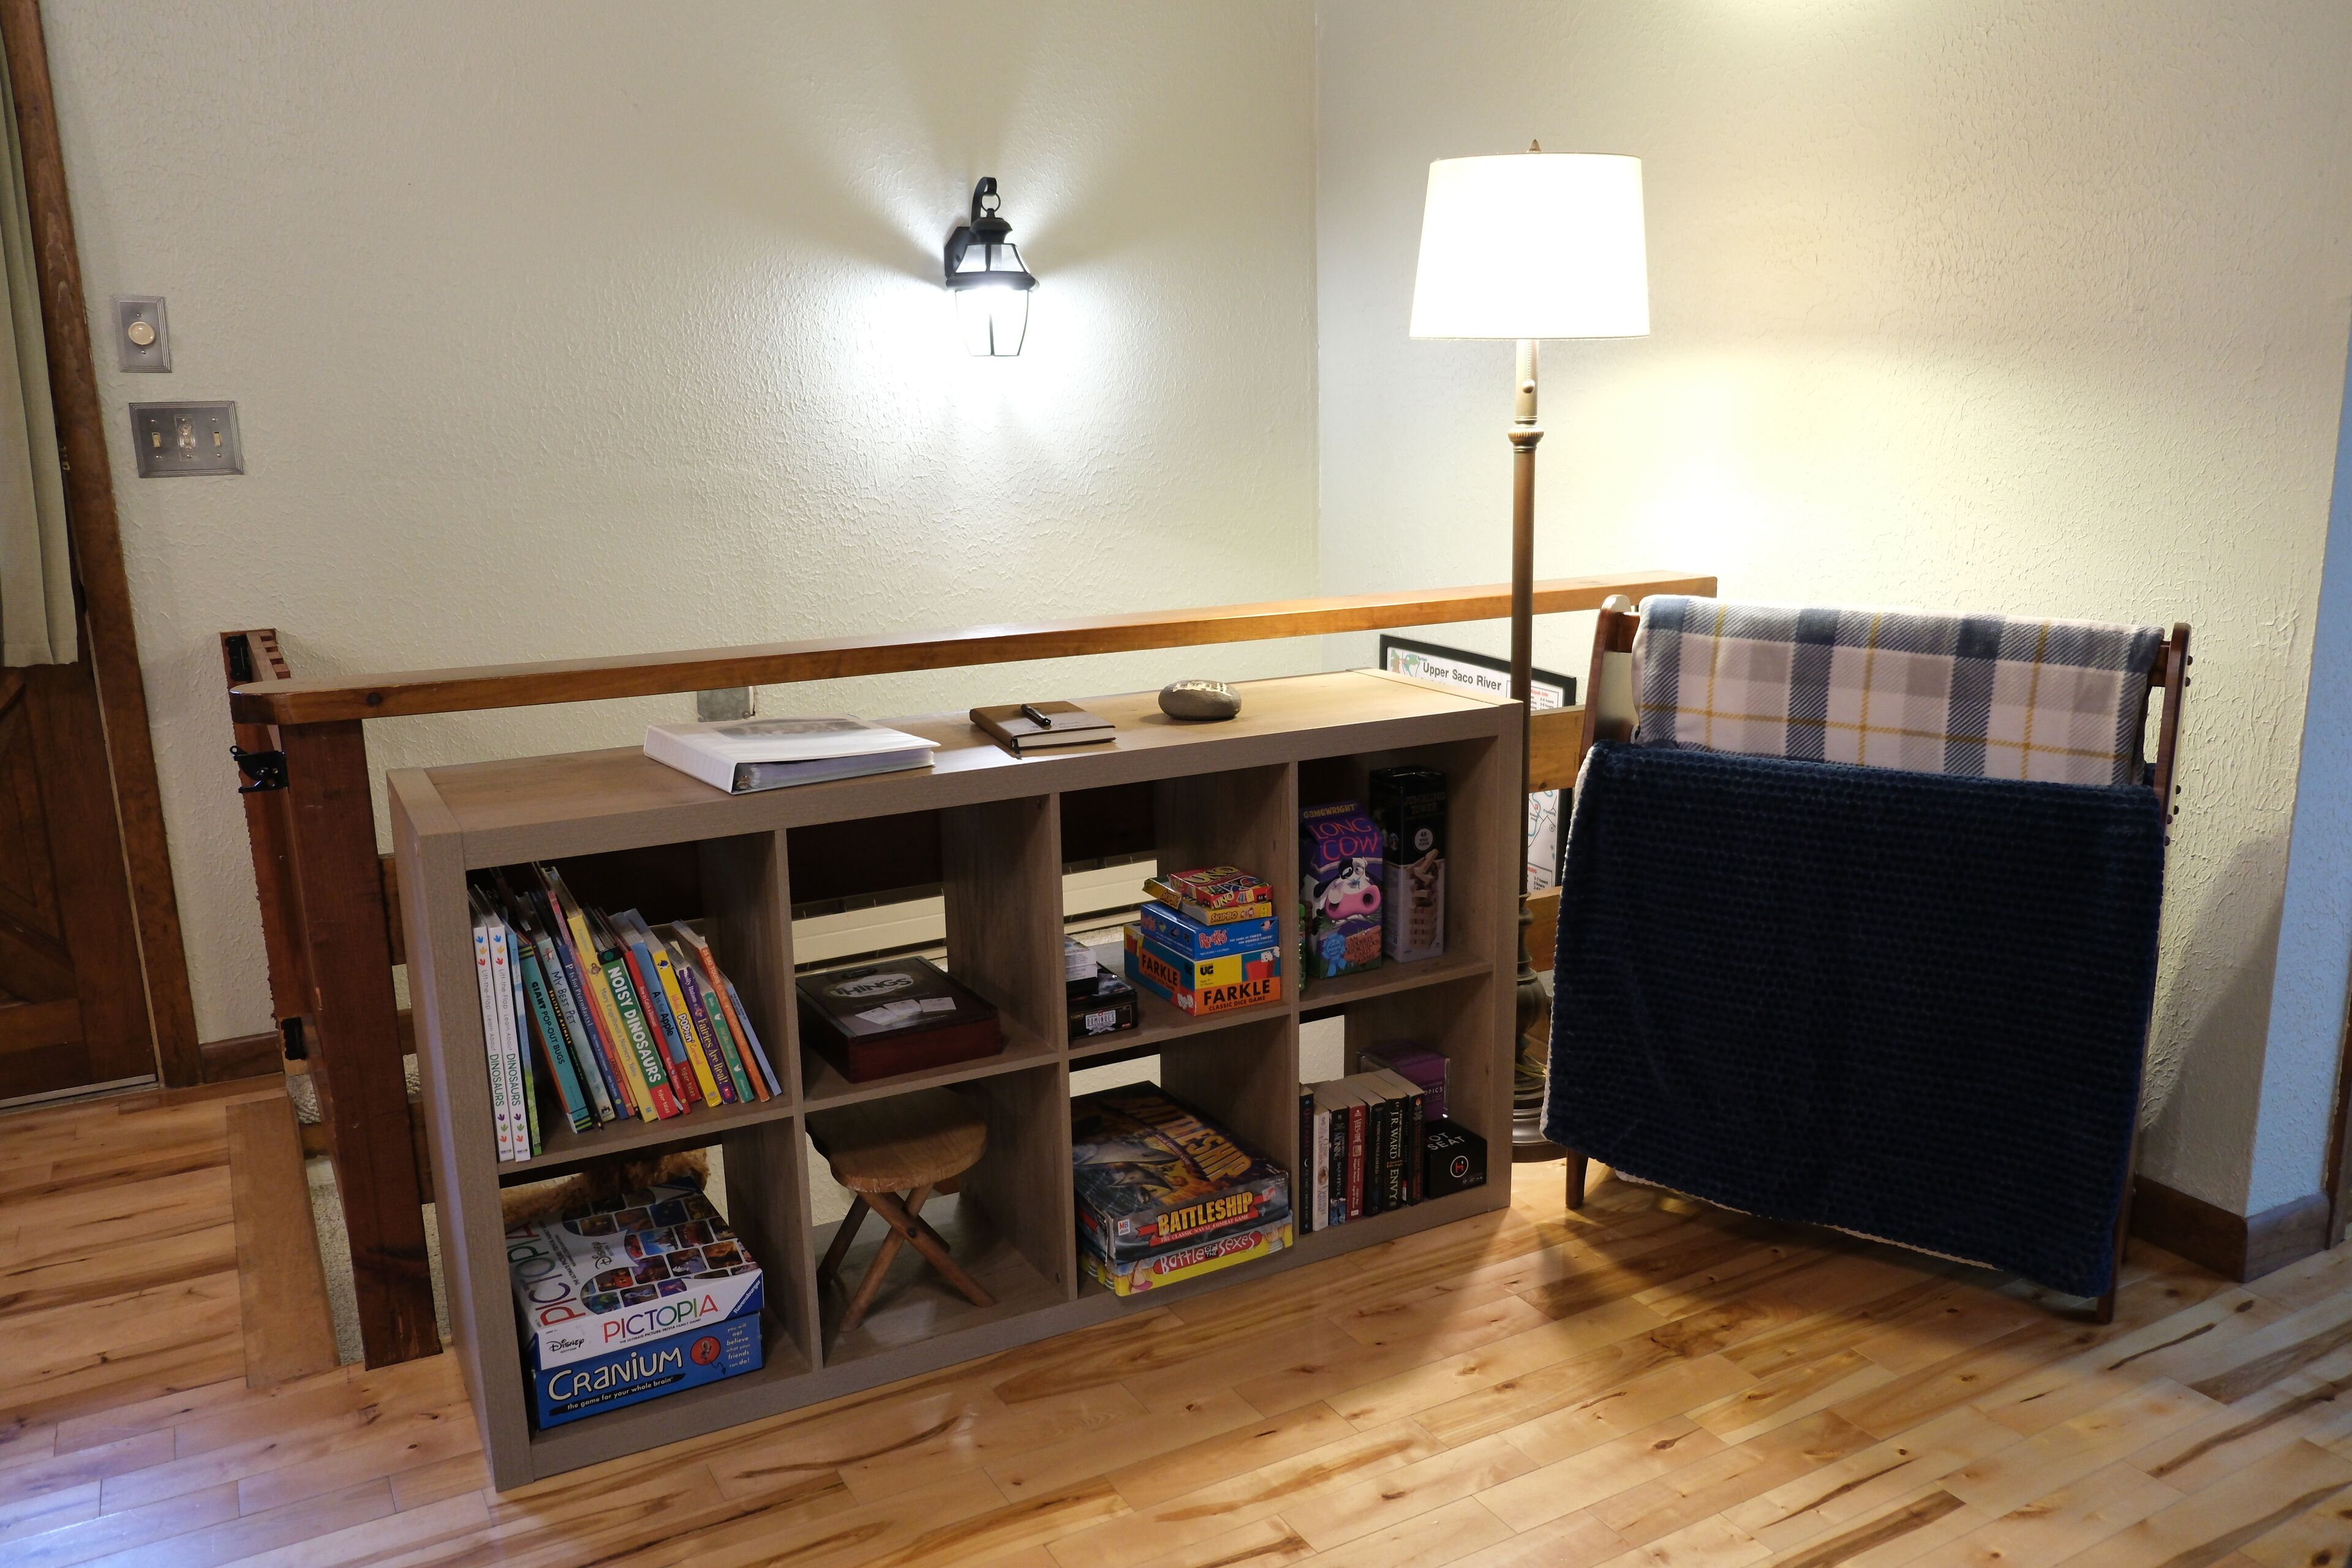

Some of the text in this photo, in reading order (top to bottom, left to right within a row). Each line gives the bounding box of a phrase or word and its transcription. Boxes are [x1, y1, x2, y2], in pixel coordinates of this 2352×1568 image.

[1423, 662, 1449, 678] Upper
[1452, 669, 1474, 684] Saco
[1476, 674, 1502, 691] River
[1308, 817, 1373, 839] LONG
[1323, 833, 1378, 861] COW
[1183, 865, 1240, 884] UNO
[1212, 891, 1235, 908] UNO
[564, 962, 574, 971] P
[570, 978, 579, 988] for
[709, 965, 720, 984] TOURS
[1142, 953, 1178, 987] FARKLE
[551, 970, 578, 1025] MY BEST PET
[834, 978, 912, 995] THINGS
[1204, 979, 1270, 1006] FARKLE
[1208, 1001, 1232, 1011] CLASSIC
[531, 981, 565, 1065] GIANT POP-OUT BUGS
[559, 1018, 572, 1044] ANIMALS
[598, 987, 611, 1004] Mary
[618, 1038, 633, 1061] Nursery
[607, 965, 662, 1084] NOISY DINOSAURS
[657, 1011, 676, 1038] Apple
[697, 1017, 715, 1048] Fairies
[1086, 1014, 1115, 1026] DOMINOES
[481, 969, 491, 1011] Lift-the-Flap
[489, 1054, 505, 1107] DINOSAURS
[499, 968, 508, 1009] Lift-the-Flap
[506, 1053, 521, 1106] DINOSAURS
[707, 1047, 721, 1063] Are
[679, 1066, 691, 1082] tiger
[712, 1062, 728, 1085] Real!
[656, 1088, 666, 1102] tiger
[1423, 1086, 1444, 1095] OPICS
[1332, 1131, 1343, 1160] MONING
[1389, 1128, 1398, 1159] WARD
[1427, 1135, 1466, 1152] SEAT
[1388, 1167, 1398, 1199] ENVY
[1119, 1220, 1129, 1229] MB
[1157, 1191, 1254, 1237] BATTLESHIP
[1172, 1230, 1194, 1240] CLASSIC
[1194, 1225, 1212, 1235] NAVAL
[1212, 1219, 1234, 1230] COMBAT
[1234, 1215, 1250, 1224] GAME
[1160, 1248, 1204, 1275] Battle
[733, 1280, 761, 1314] Ravensburger
[603, 1294, 719, 1344] PICTOPIA
[627, 1333, 644, 1342] ULTIMATE
[644, 1325, 675, 1338] PICTURE-TRIVIA
[676, 1321, 689, 1330] FAMILY
[726, 1336, 749, 1346] believe
[728, 1350, 750, 1360] friends
[739, 1357, 750, 1366] do!
[548, 1346, 683, 1401] CRANIUM
[567, 1378, 672, 1411] the game for your whole brain
